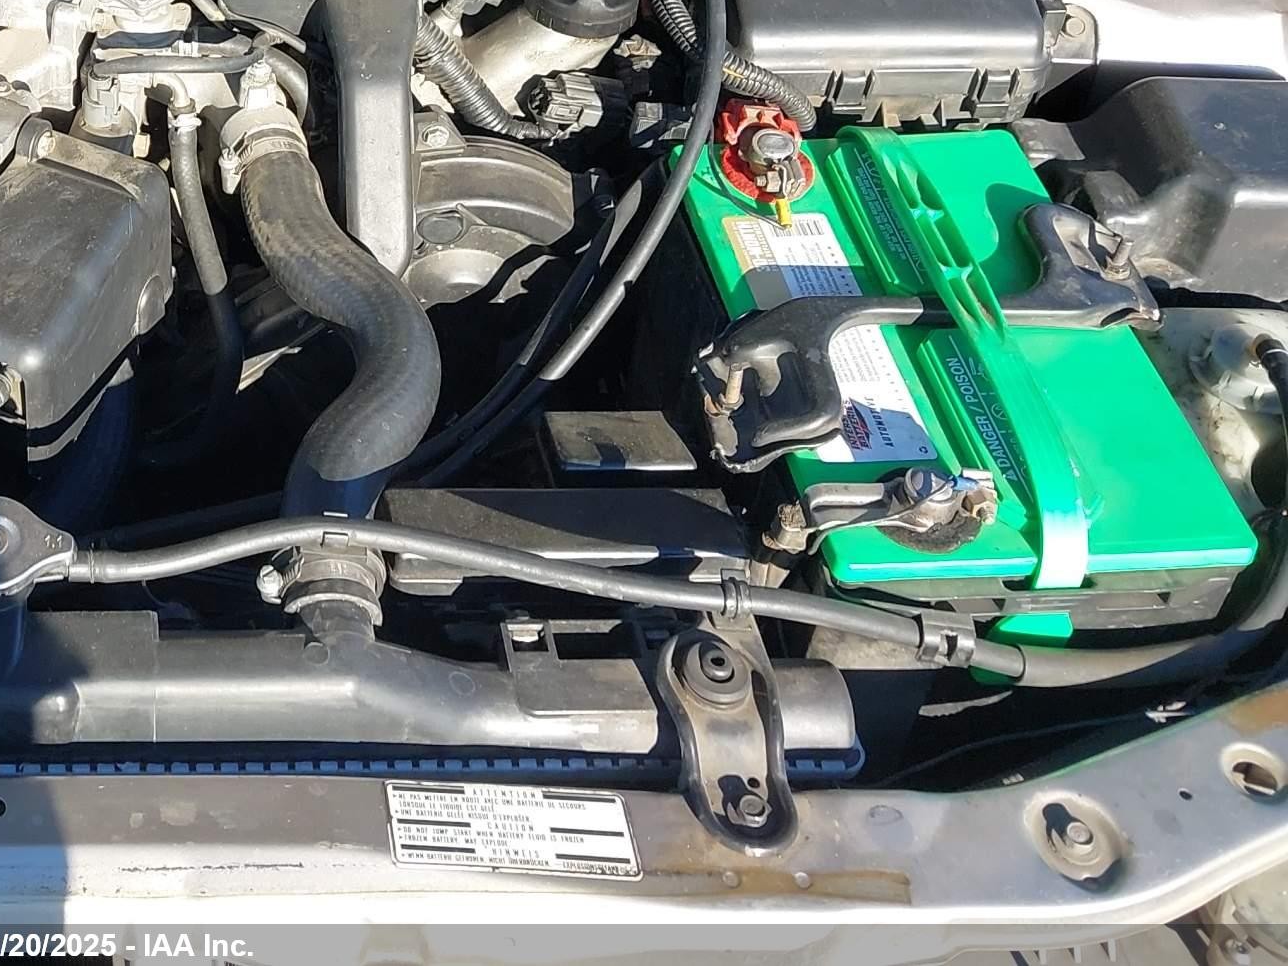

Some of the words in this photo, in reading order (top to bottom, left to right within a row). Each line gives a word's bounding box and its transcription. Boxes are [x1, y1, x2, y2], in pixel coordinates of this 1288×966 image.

[948, 356, 979, 403] POISON
[863, 397, 896, 447] AUTOMOTIVE
[977, 415, 1012, 467] DANGER
[472, 788, 537, 799] ATTENTION
[487, 822, 534, 832] CAUTION
